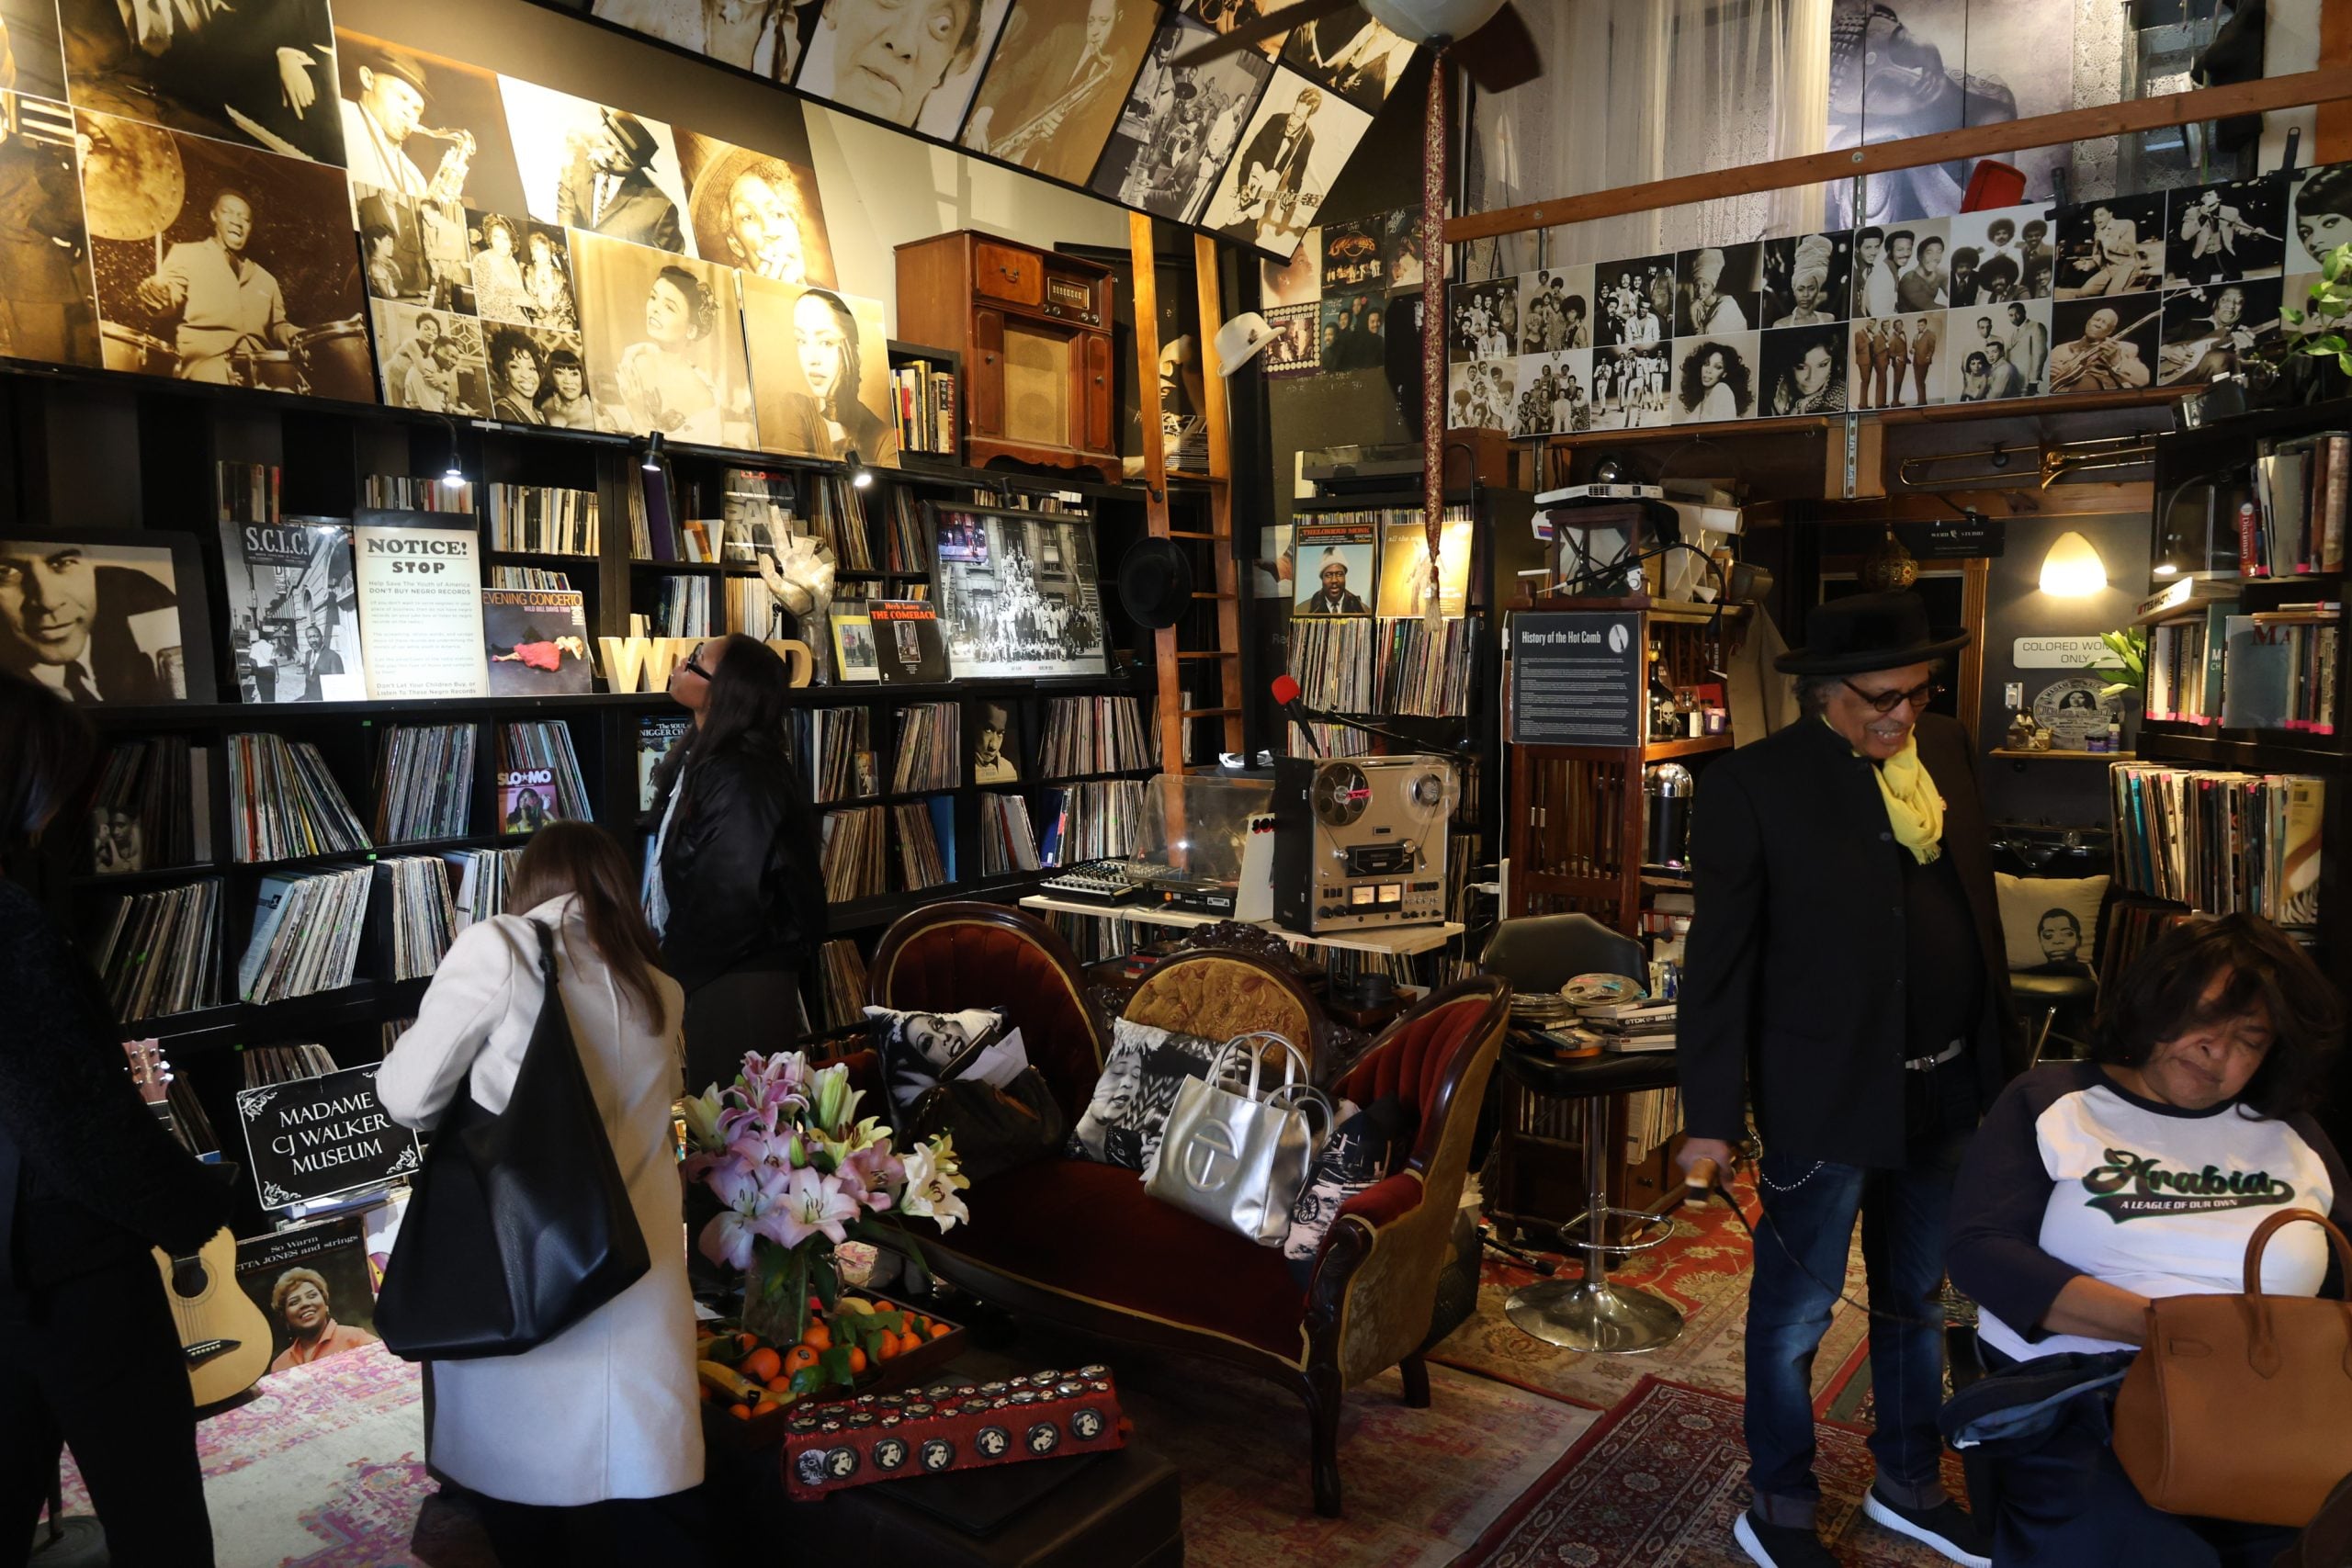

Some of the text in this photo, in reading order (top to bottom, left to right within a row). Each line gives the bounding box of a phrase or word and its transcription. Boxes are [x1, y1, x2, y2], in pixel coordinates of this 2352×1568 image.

[367, 538, 467, 555] NOTICE!
[392, 561, 446, 573] STOP
[482, 592, 527, 605] EVENING
[529, 593, 582, 606] CONCERTO
[871, 611, 936, 620] THE COMEBACK
[1521, 631, 1601, 646] History of the Hot Comb
[2022, 641, 2078, 651] COLORED
[2060, 654, 2090, 663] ONLY
[279, 1091, 375, 1128] MADAME
[272, 1113, 391, 1156] CJ WALKER
[291, 1138, 383, 1176] MUSEUM
[2120, 1199, 2238, 1210] A LEAGUE OF OUR OWN
[271, 1235, 319, 1253] So Warm
[236, 1235, 358, 1272] TTA JONES and strings
